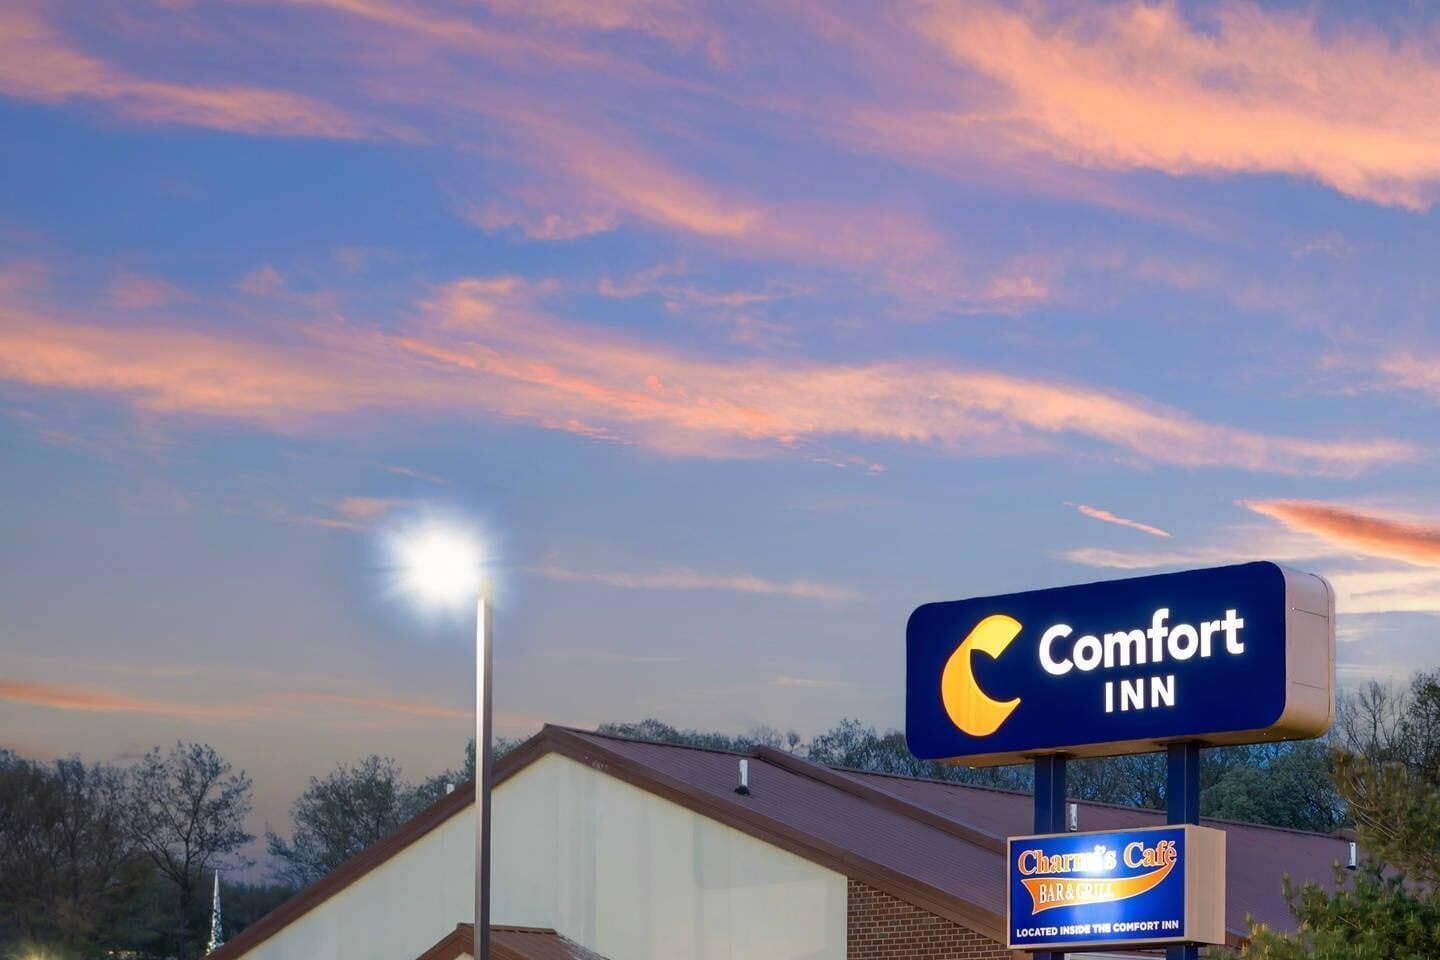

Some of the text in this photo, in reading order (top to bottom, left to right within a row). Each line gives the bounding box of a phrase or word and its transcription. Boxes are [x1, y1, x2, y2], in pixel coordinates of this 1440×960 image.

[1039, 608, 1244, 675] Comfort
[1105, 675, 1176, 713] INN
[1123, 840, 1177, 868] Café
[1016, 920, 1179, 938] LOCATED INSIDE THE COMFORT INN
